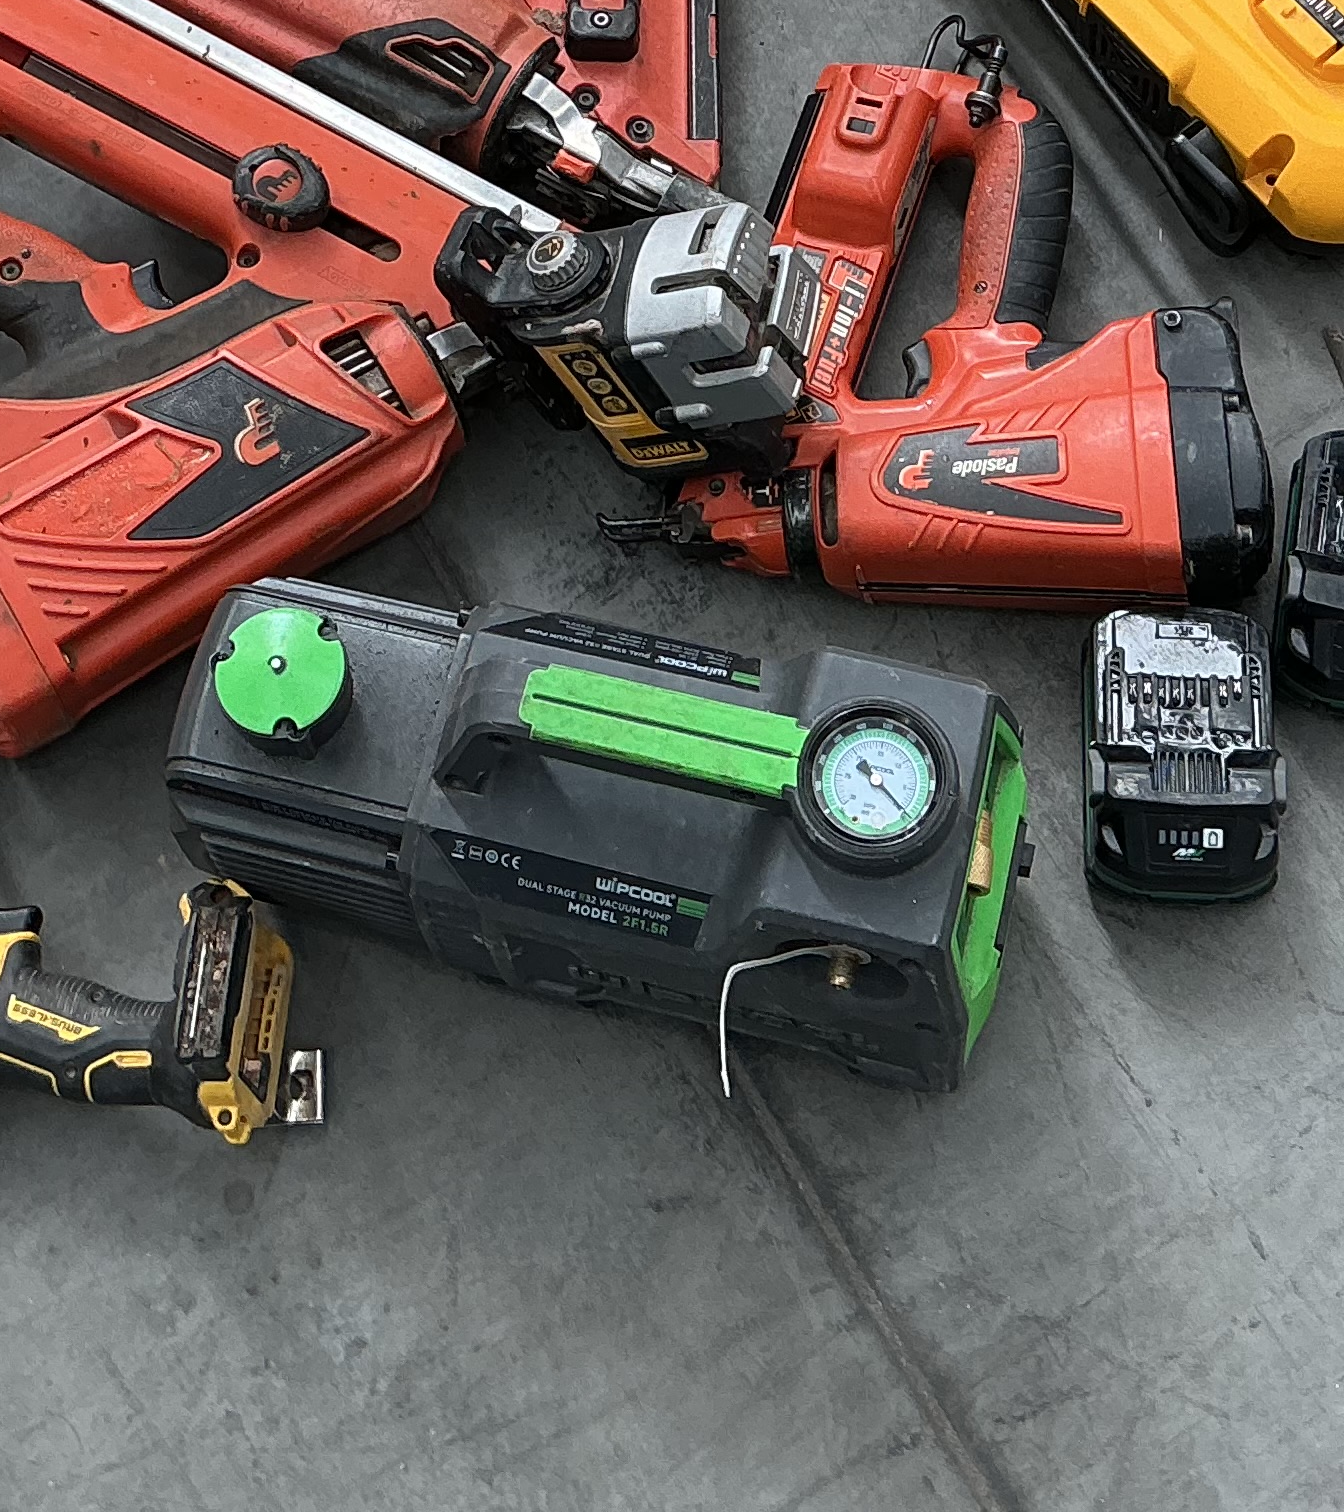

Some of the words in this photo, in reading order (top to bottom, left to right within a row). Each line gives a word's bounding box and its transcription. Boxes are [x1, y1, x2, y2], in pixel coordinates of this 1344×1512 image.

[628, 441, 691, 458] DEWALT
[951, 455, 1018, 476] Paslode
[516, 876, 545, 892] DUAL
[545, 883, 577, 900] STAGE
[597, 897, 641, 916] VACUUM
[641, 908, 672, 923] PUMP
[594, 875, 675, 907] WIPCOOL
[566, 901, 619, 924] MODEL
